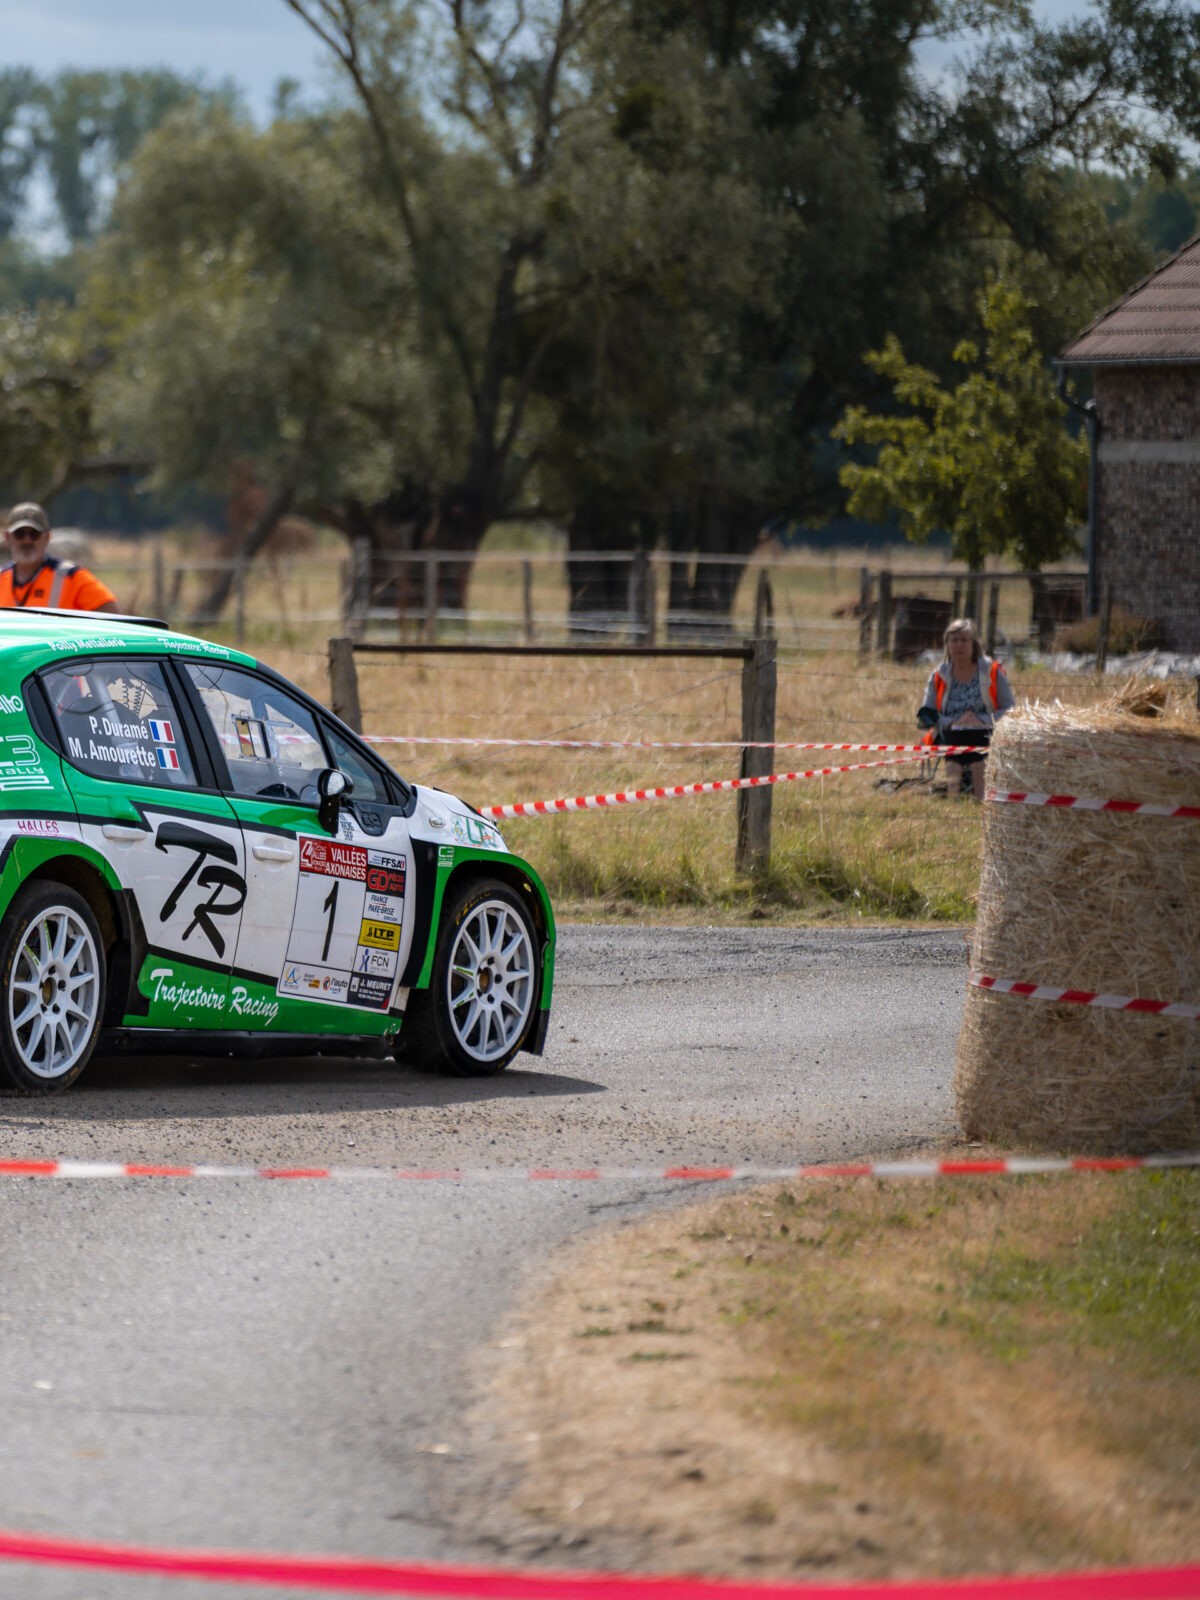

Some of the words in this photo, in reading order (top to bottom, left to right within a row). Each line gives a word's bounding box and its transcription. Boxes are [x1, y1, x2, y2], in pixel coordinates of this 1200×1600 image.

[89, 716, 102, 735] P.
[102, 716, 149, 740] Duramé
[68, 737, 88, 759] M.
[90, 739, 156, 768] Amourette
[17, 820, 59, 833] HALLES
[331, 847, 367, 867] VALLÉES
[381, 857, 403, 869] FFSA
[324, 862, 367, 881] AXONAISES
[367, 868, 389, 892] GD
[155, 821, 247, 959] TR
[322, 881, 339, 962] 1
[371, 955, 390, 967] FCN
[150, 968, 225, 1012] Trajectoire
[229, 985, 280, 1027] Racing
